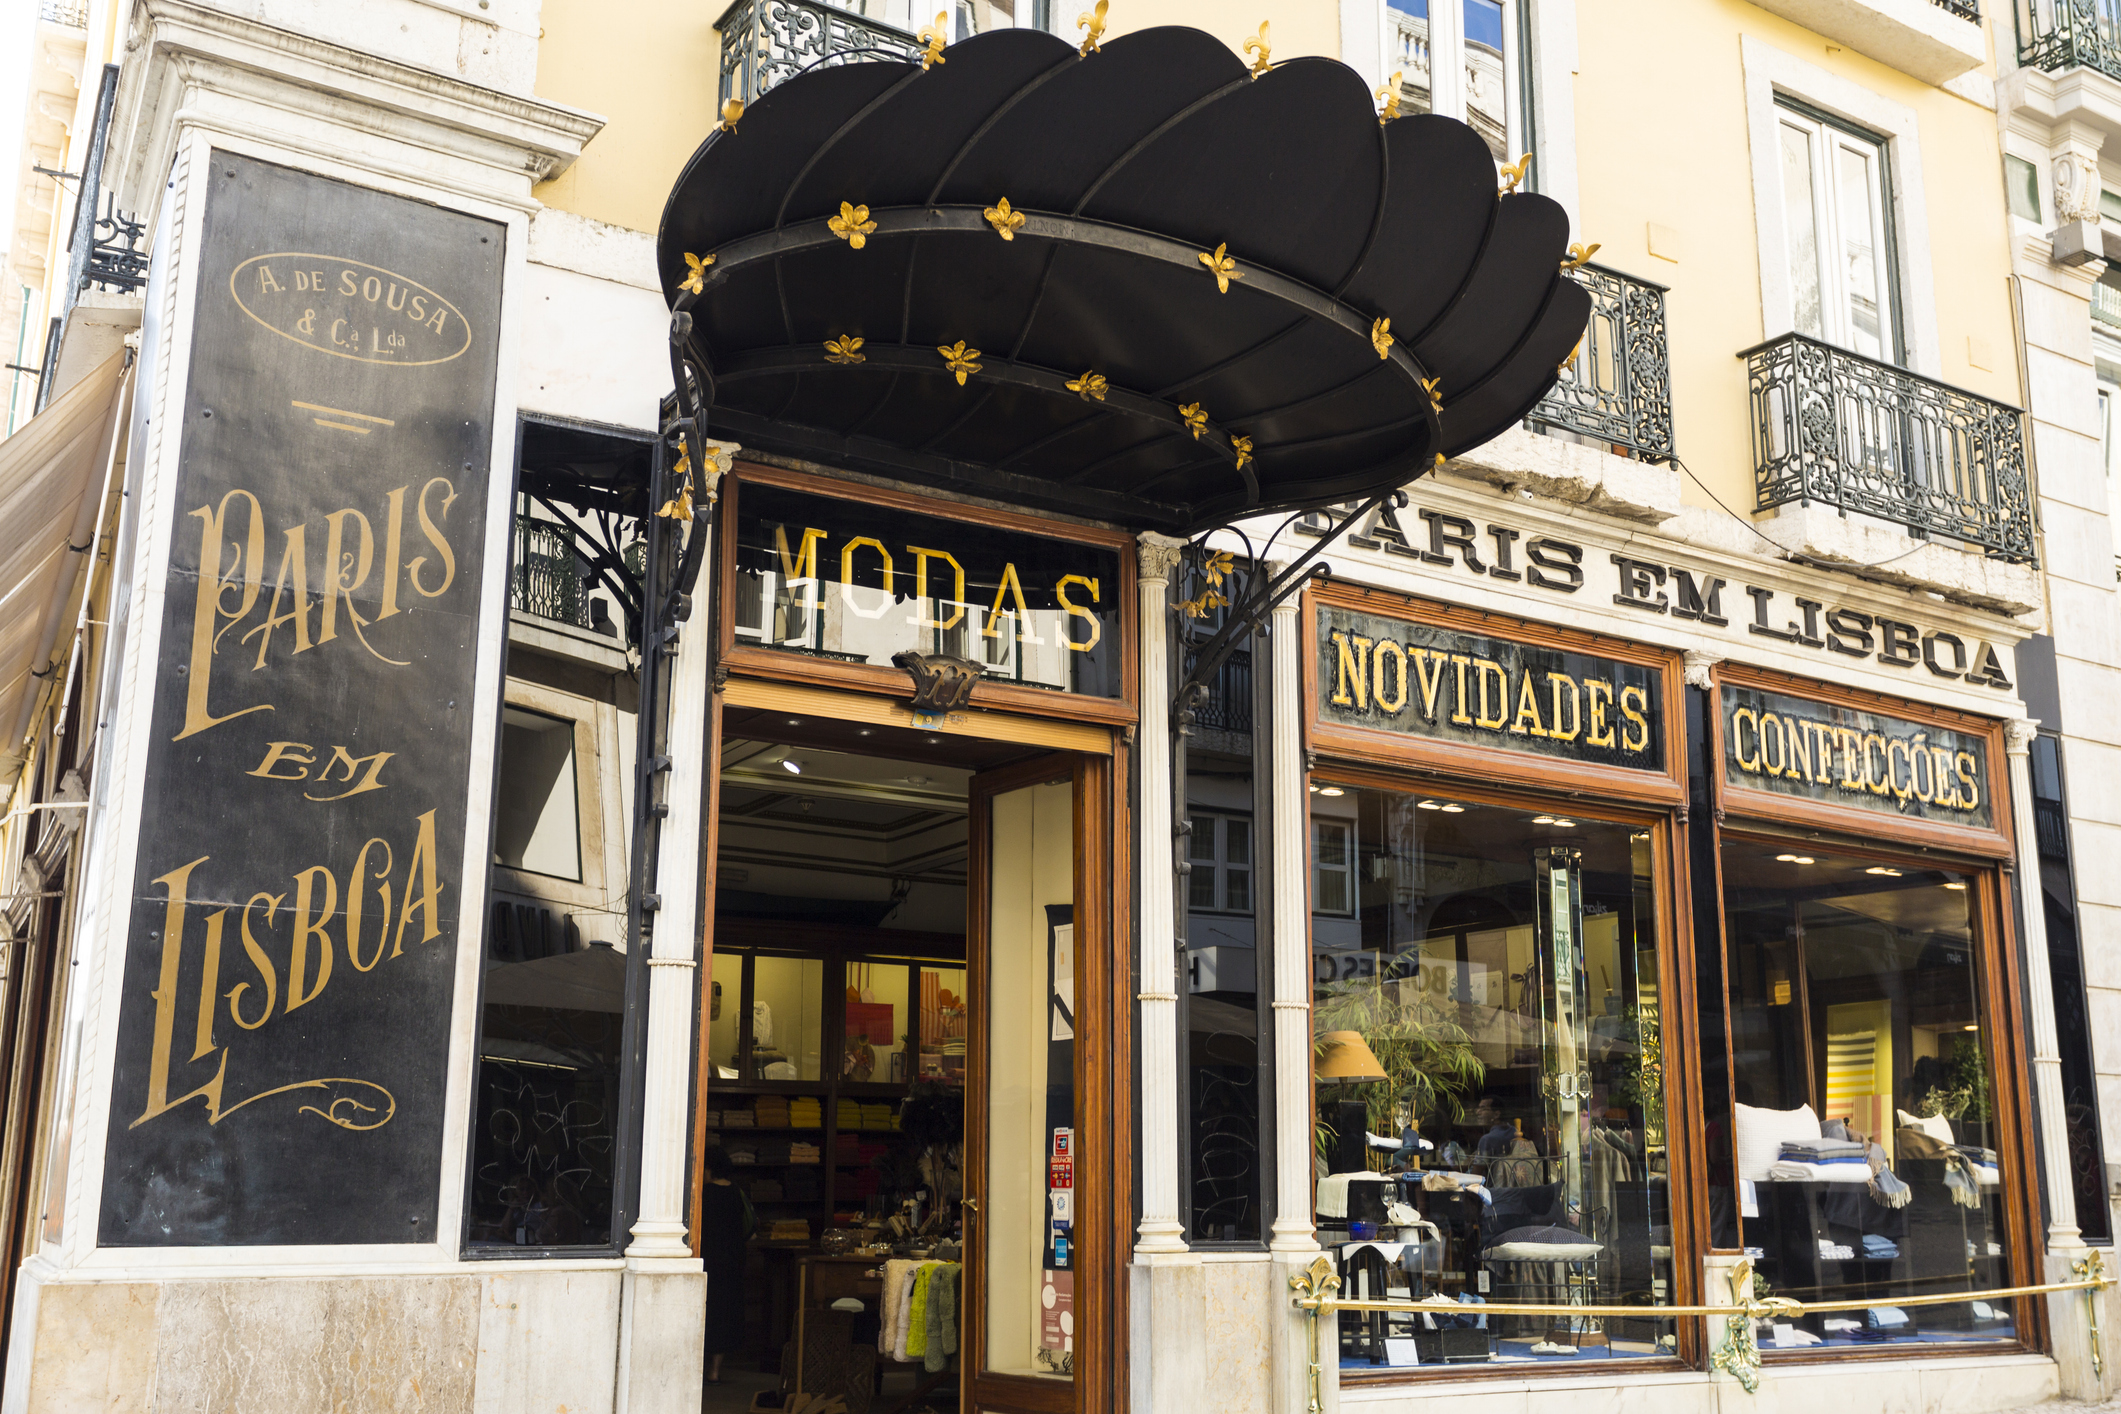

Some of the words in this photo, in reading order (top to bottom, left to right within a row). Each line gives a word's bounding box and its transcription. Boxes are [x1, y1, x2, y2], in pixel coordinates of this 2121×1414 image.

[258, 265, 286, 294] A.
[294, 270, 326, 292] DE
[337, 269, 449, 336] SOUSA
[296, 308, 316, 336] &
[172, 476, 458, 742] PARIS
[772, 522, 1101, 653] MODAS
[1609, 552, 1730, 628] EM
[1745, 584, 2014, 690] LISBOA
[1331, 632, 1649, 752] NOVIDADES
[245, 740, 397, 801] EM
[128, 807, 444, 1130] LISBOA
